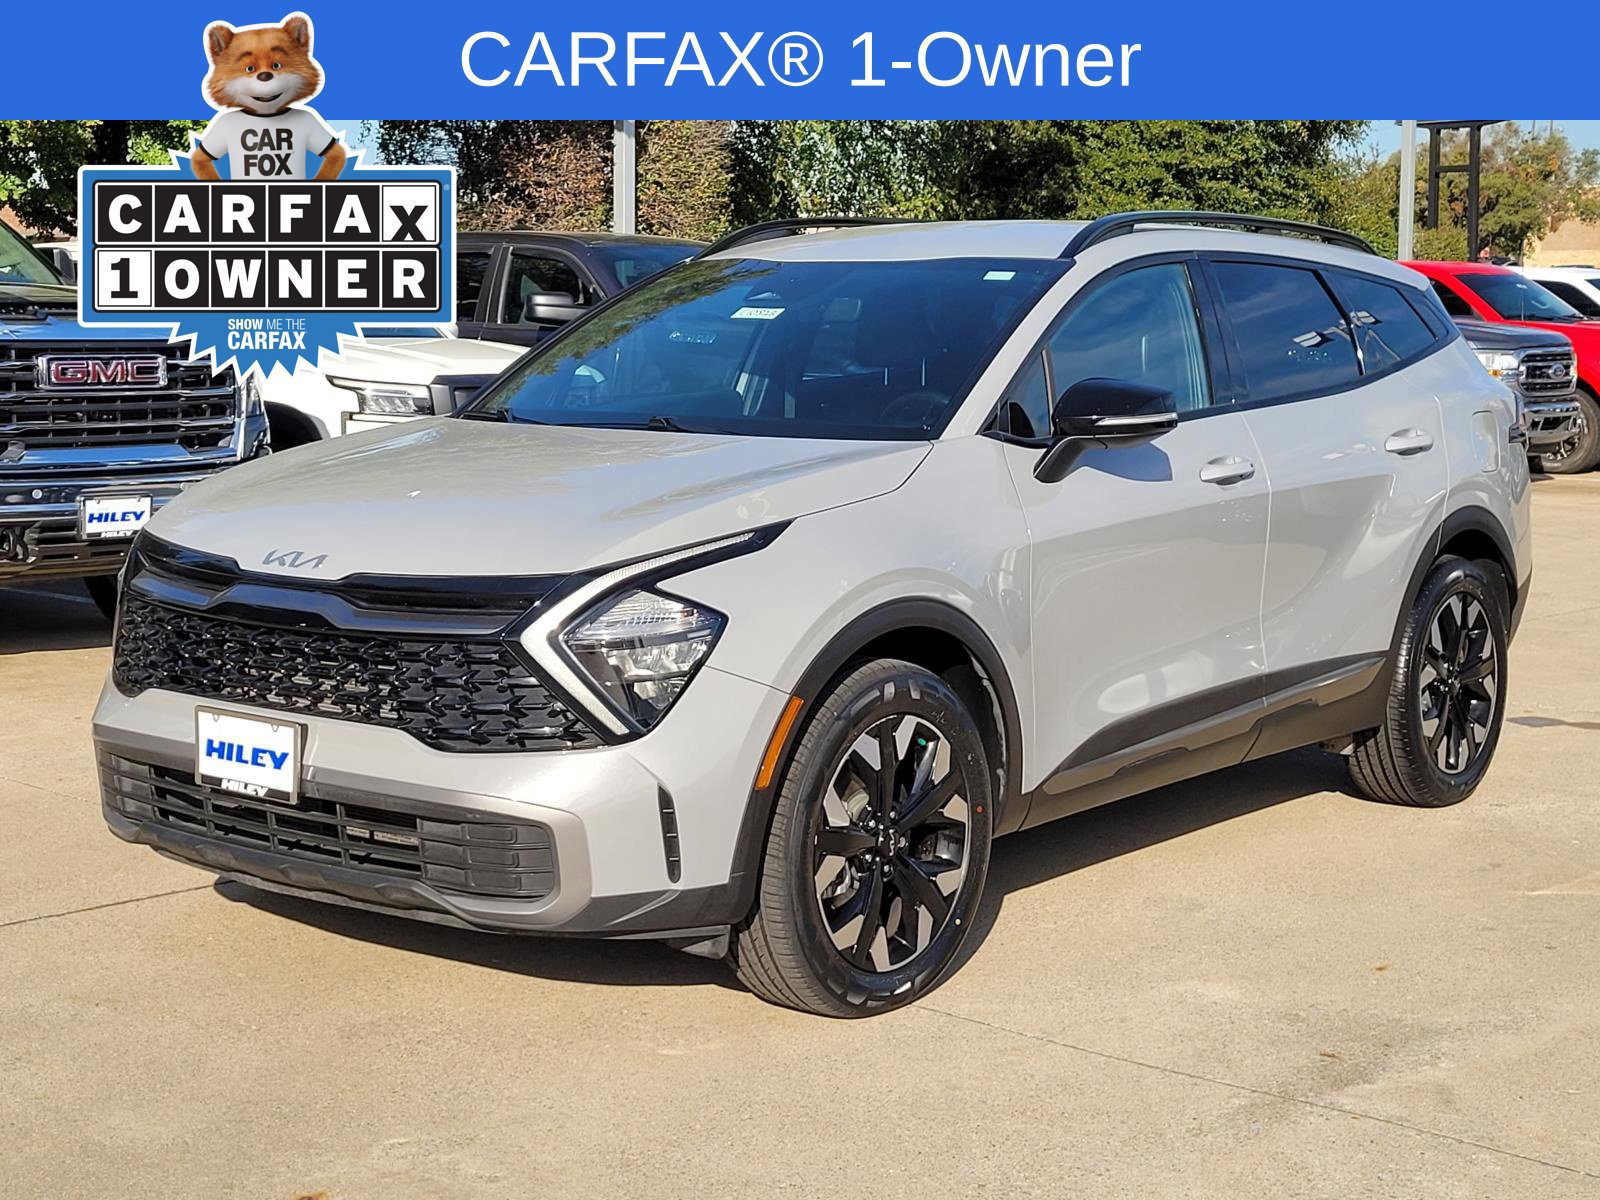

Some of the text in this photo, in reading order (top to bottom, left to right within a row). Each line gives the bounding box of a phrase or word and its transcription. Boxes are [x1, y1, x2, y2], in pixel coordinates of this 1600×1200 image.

[51, 359, 160, 383] GMC
[87, 510, 146, 524] HILEY
[205, 738, 290, 770] HILEY
